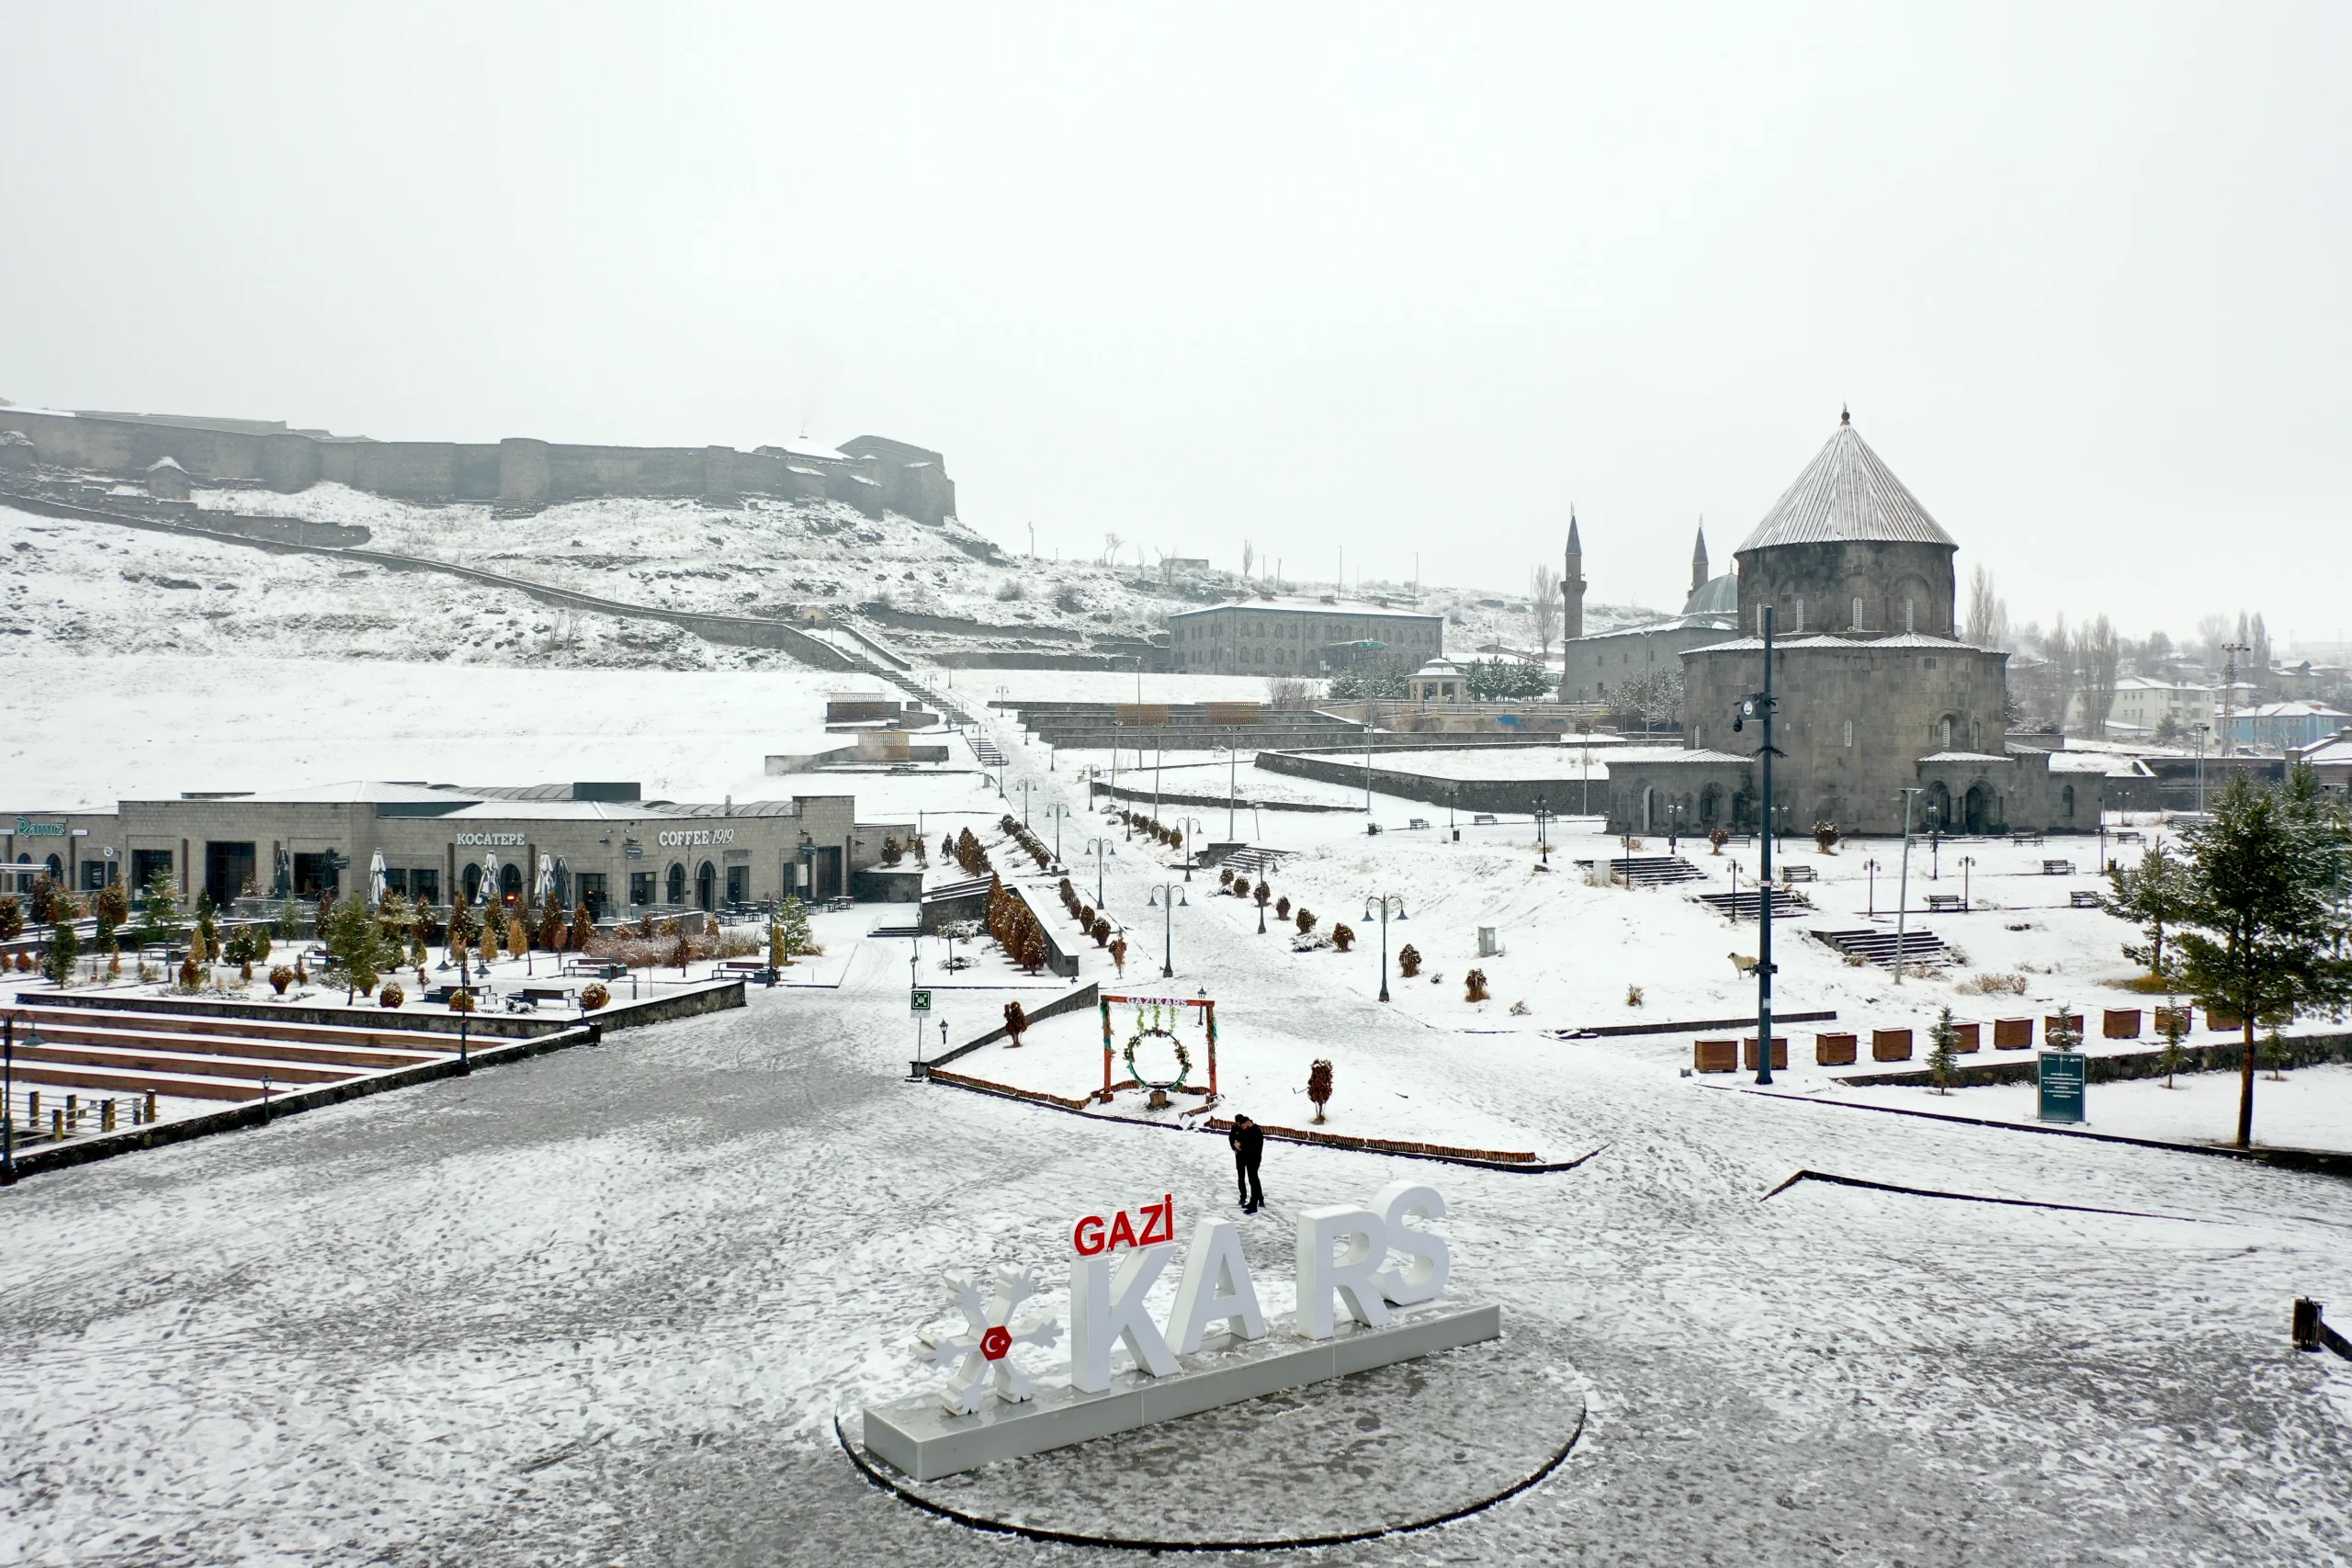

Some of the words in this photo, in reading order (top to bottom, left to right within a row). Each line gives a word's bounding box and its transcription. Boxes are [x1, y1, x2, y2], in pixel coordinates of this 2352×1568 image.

[457, 832, 526, 846] KOCATEPE
[658, 830, 709, 847] COFFEE
[1157, 998, 1188, 1007] KARS
[1069, 1192, 1174, 1257] GAZİ
[1069, 1179, 1451, 1394] KARS
